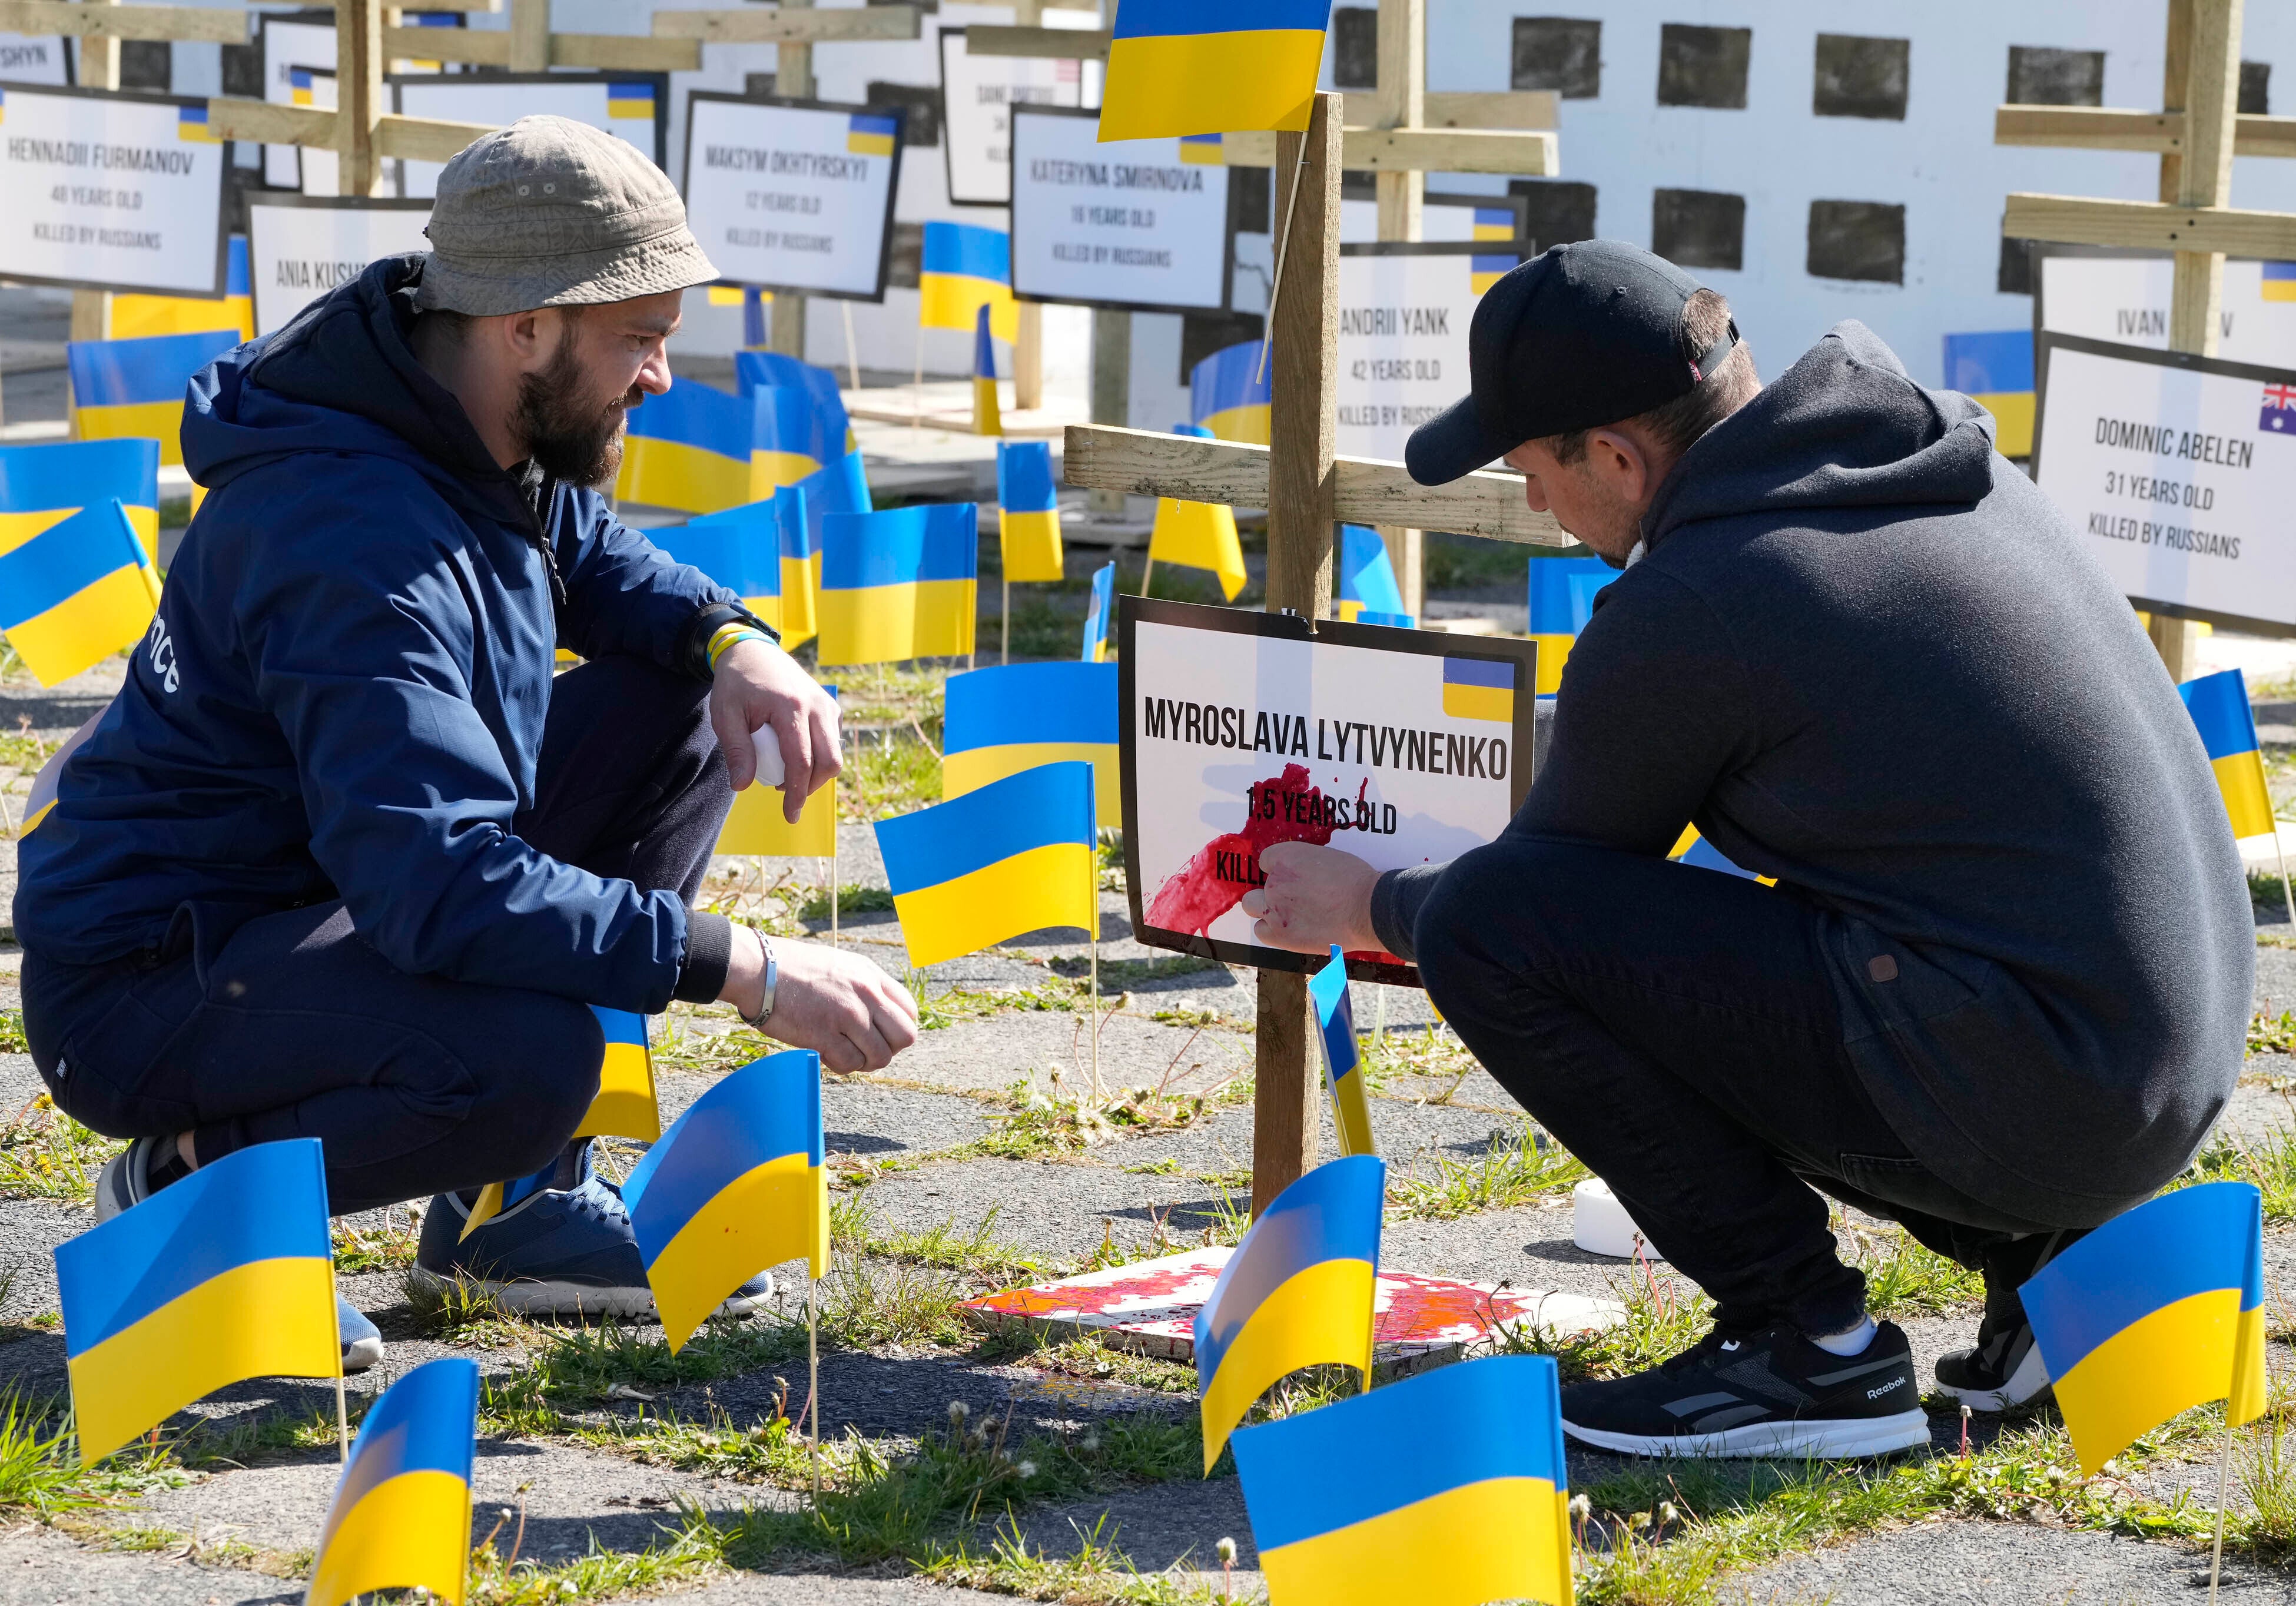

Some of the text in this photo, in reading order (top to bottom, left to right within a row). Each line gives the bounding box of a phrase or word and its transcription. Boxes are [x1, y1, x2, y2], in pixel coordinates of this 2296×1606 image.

[8, 137, 194, 175] HENNADII FURMANOV
[705, 144, 768, 174] MAKSYM
[1031, 159, 1203, 193] KATERYNA SMIRNOVA
[71, 185, 112, 207] YEARS
[116, 190, 144, 210] OLD
[762, 191, 797, 213] YEARS
[799, 195, 822, 215] OLD
[1089, 206, 1127, 227] YEARS
[1130, 208, 1155, 228] OLD
[34, 223, 161, 250] KILLED BY RUSSIANS
[726, 227, 832, 254] KILLED BY RUSSIANS
[1052, 243, 1172, 268] KILLED BY RUSSIANS
[276, 260, 310, 288] ANIA
[1341, 308, 1450, 336] ANDRII YANK
[2118, 309, 2165, 336] IVAN
[1352, 360, 1441, 380] 42 YEARS OLD
[1338, 405, 1379, 426] KILLED
[1382, 406, 1398, 426] BY
[2095, 417, 2254, 470] DOMINIC ABELEN
[2105, 470, 2214, 510] 31 YEARS OLD
[2088, 512, 2241, 560] KILLED BY RUSSIANS
[1145, 696, 1507, 781] MYROSLAVA LYTVYNENKO
[1246, 787, 1396, 835] 1,5 YEARS OLD
[1866, 1376, 1906, 1399] Reebok
